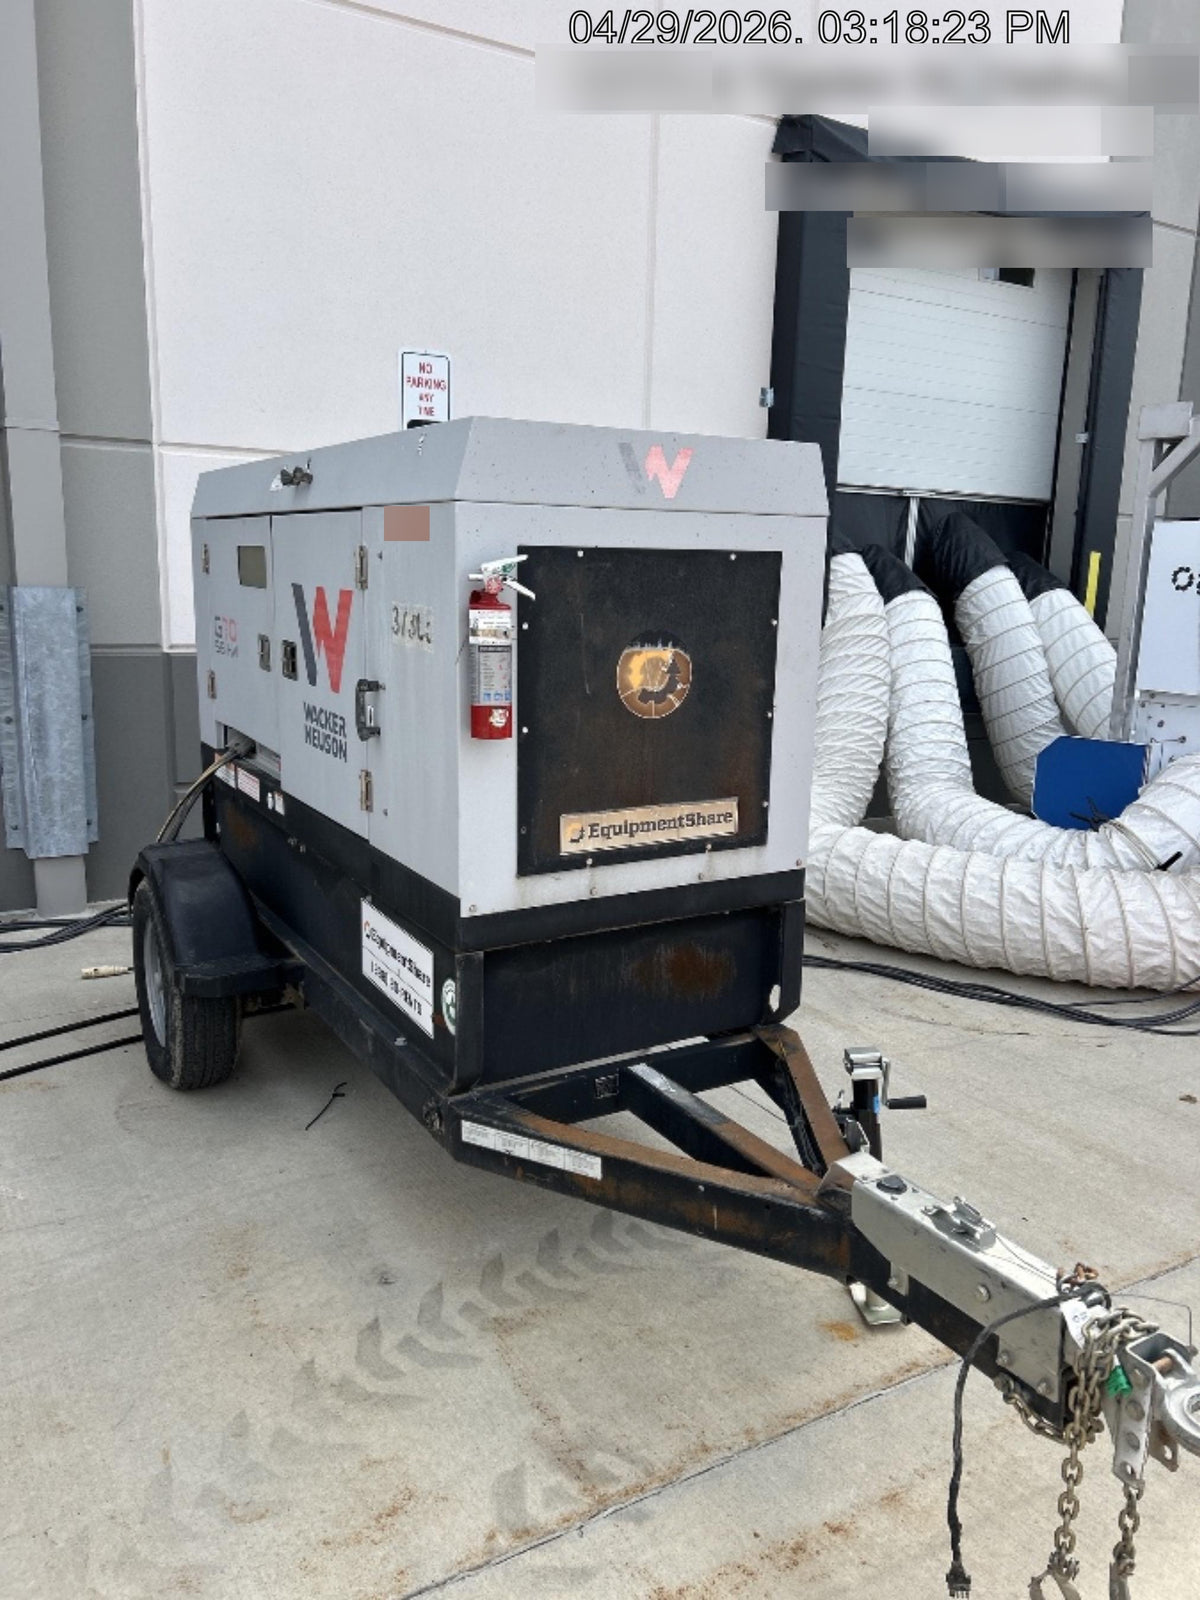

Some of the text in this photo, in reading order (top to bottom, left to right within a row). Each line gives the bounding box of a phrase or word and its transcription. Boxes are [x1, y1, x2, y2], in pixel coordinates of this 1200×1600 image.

[418, 361, 433, 374] NO
[406, 376, 447, 392] PARKING
[303, 701, 347, 739] WACKER
[304, 724, 348, 764] NEUSON
[588, 811, 733, 838] EquipmentShare
